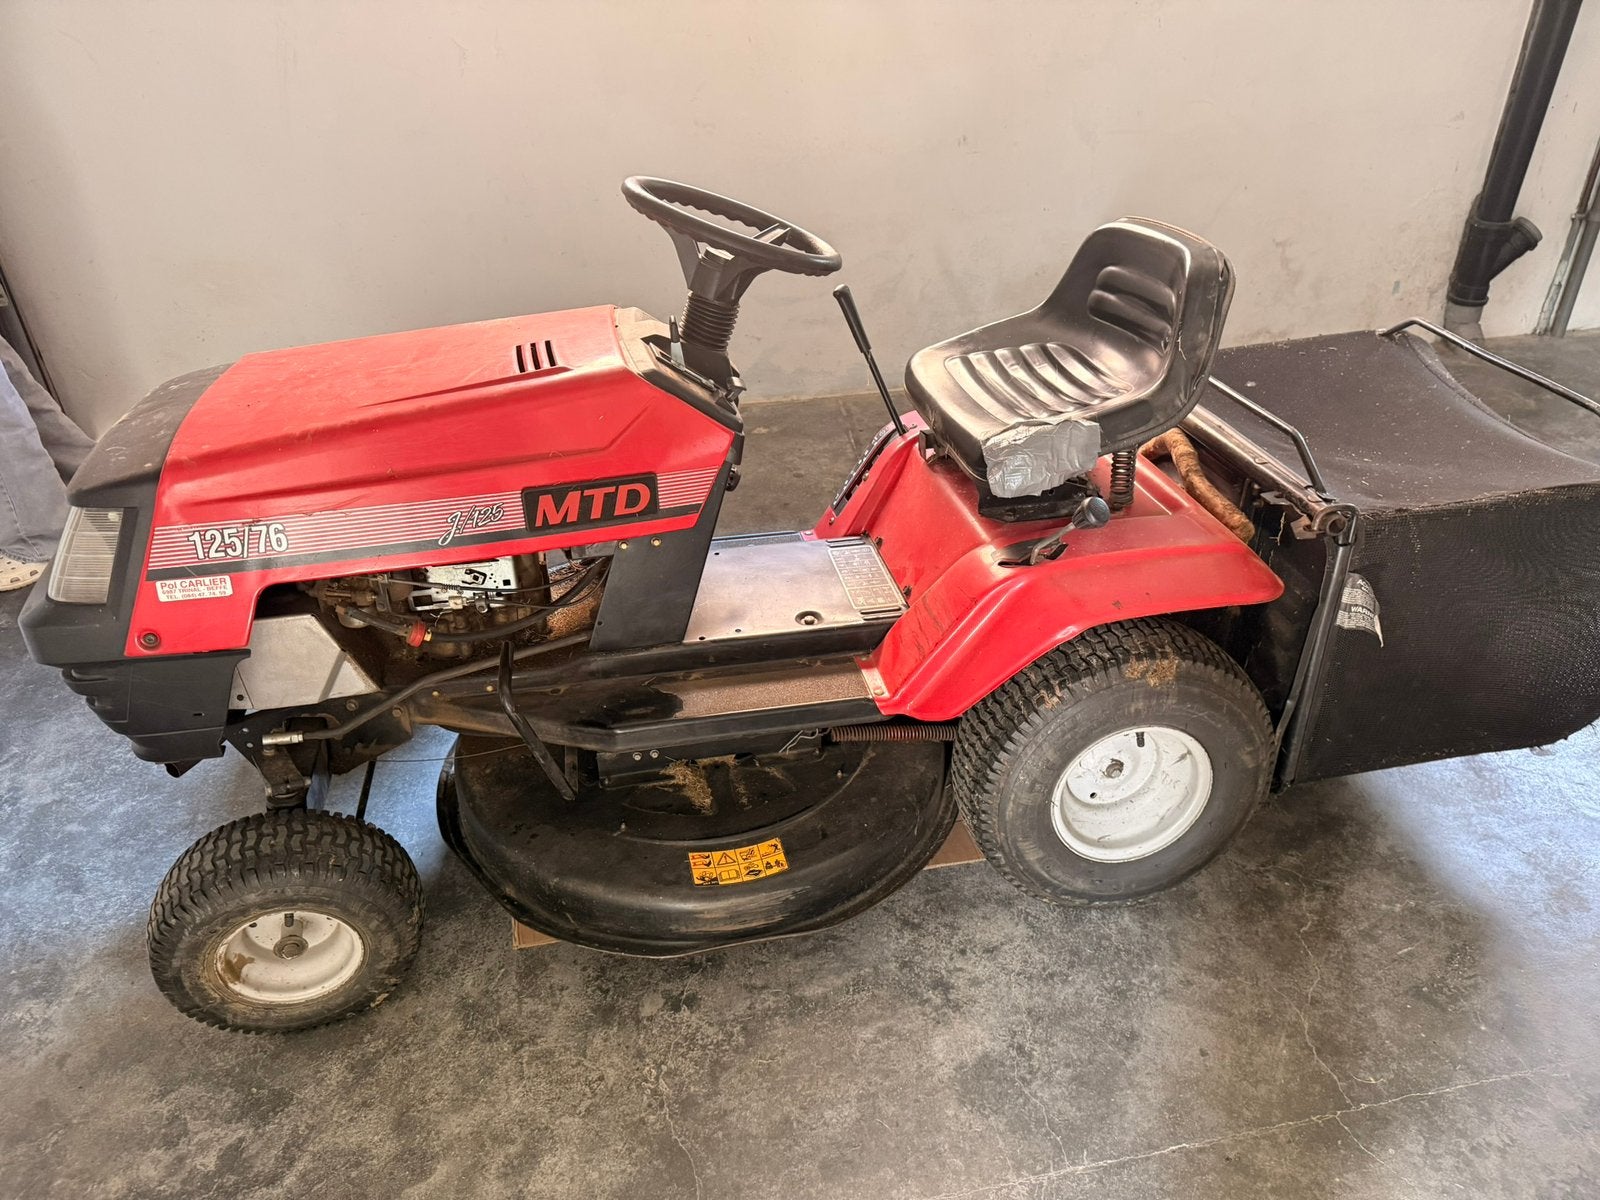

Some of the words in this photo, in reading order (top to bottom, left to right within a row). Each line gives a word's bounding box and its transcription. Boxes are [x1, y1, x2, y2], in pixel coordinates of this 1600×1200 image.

[438, 502, 504, 546] J/125
[536, 483, 650, 527] MTD
[188, 523, 289, 560] 125/76
[160, 582, 177, 590] Pol
[180, 578, 227, 588] CARLIER
